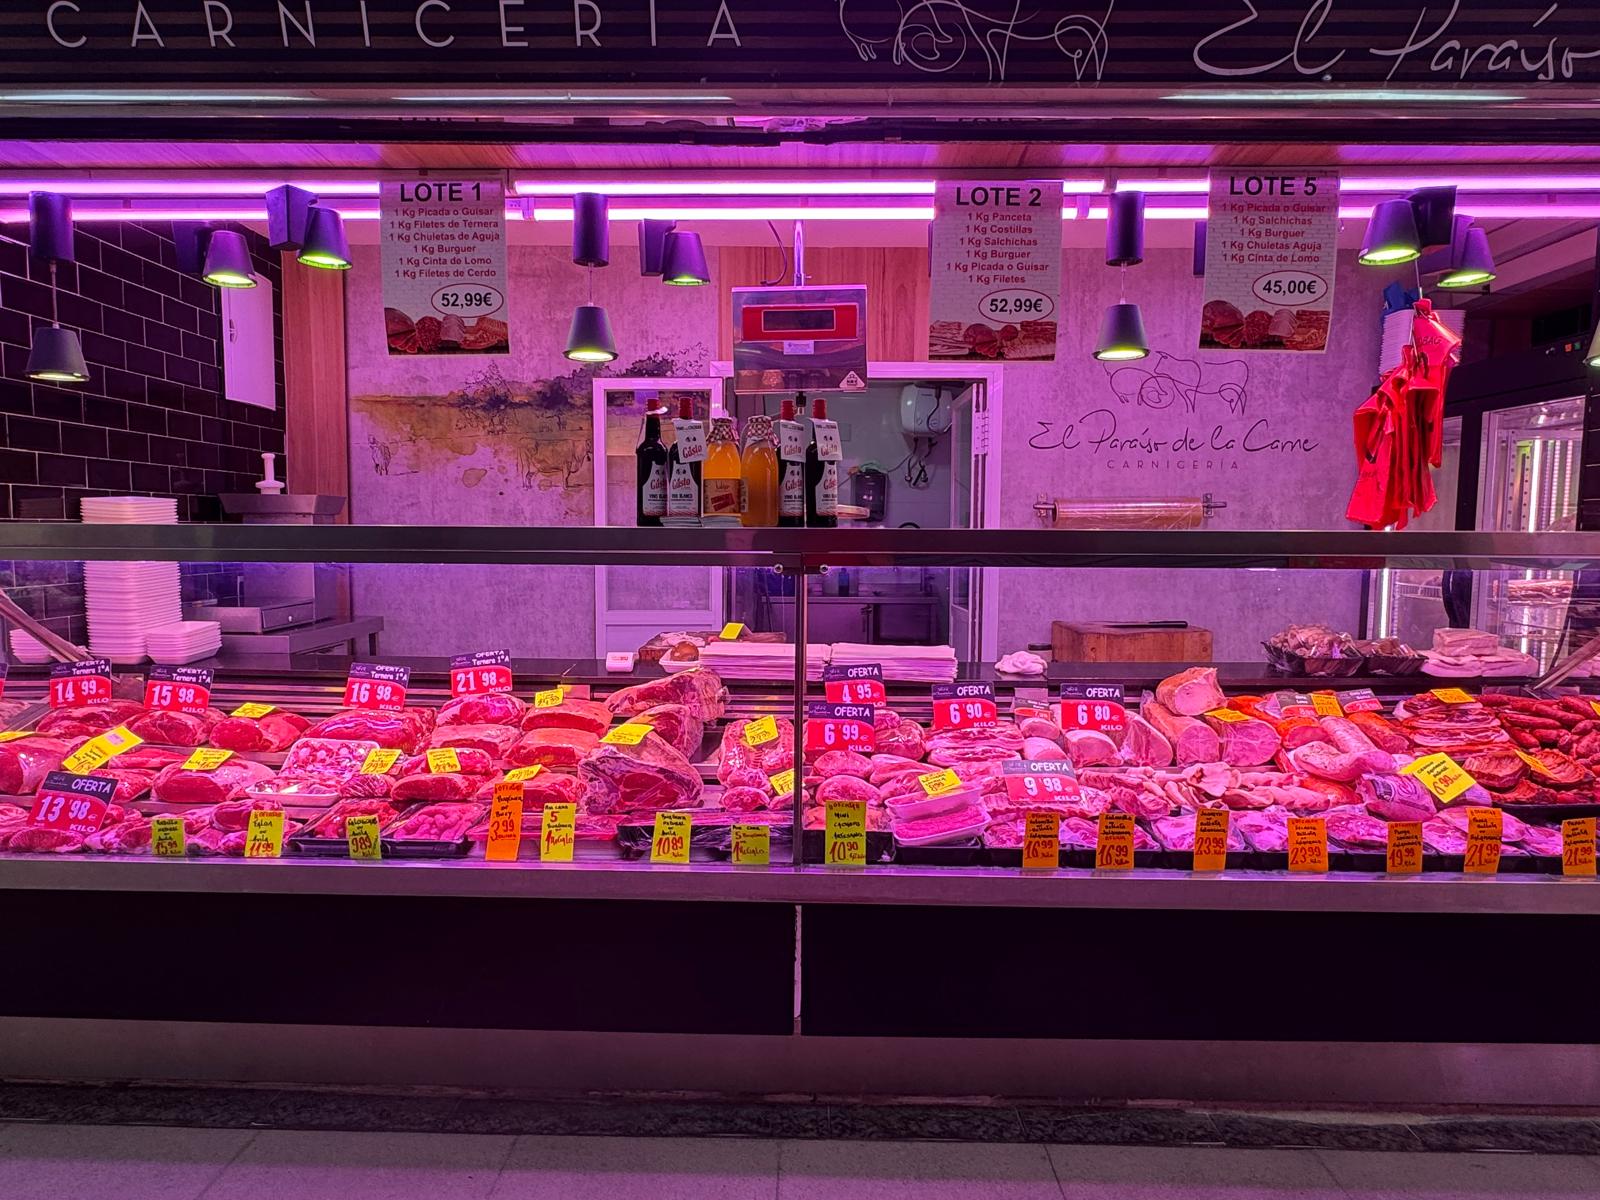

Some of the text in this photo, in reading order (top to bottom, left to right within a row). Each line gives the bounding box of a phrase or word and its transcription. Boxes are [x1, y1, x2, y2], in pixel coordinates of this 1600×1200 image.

[1229, 176, 1317, 196] LOTE 5
[400, 183, 482, 202] LOTE 1
[956, 187, 1042, 206] LOTE 2
[402, 208, 416, 218] Kg
[418, 208, 450, 216] Picada
[461, 208, 494, 216] Guisar
[1230, 203, 1244, 213] Kg
[1247, 203, 1280, 212] Picada
[1292, 203, 1326, 213] Guisar
[976, 213, 989, 222] Kg
[993, 213, 1032, 221] Panceta
[1242, 216, 1255, 226] Kg
[1258, 216, 1312, 225] Salchichas
[398, 220, 411, 230] Kg
[414, 220, 445, 229] Filetes
[448, 220, 459, 228] de
[463, 220, 499, 228] Ternera
[974, 225, 987, 235] Kg
[990, 225, 1033, 234] Costillas
[397, 233, 411, 243] Kg
[413, 233, 455, 241] Chuletas
[457, 233, 470, 241] de
[472, 233, 500, 242] Aguja
[1248, 229, 1262, 238] Kg
[1265, 228, 1305, 239] Burguer
[968, 238, 981, 247] Kg
[984, 237, 1038, 246] Salchichas
[1230, 241, 1244, 251] Kg
[1247, 240, 1290, 250] Chuletas
[1292, 241, 1322, 252] Aguja
[421, 245, 435, 255] Kg
[437, 245, 477, 255] Burguer
[974, 250, 988, 260] Kg
[990, 250, 1031, 260] Burguer
[406, 257, 420, 267] Kg
[422, 257, 447, 265] Cinta
[450, 257, 461, 265] de
[465, 257, 492, 265] Lomo
[1231, 254, 1245, 264] Kg
[1247, 253, 1273, 262] Cinta
[1276, 254, 1288, 262] de
[1291, 254, 1320, 262] Lomo
[954, 263, 968, 272] Kg
[971, 262, 1003, 271] Picada
[1016, 263, 1049, 271] Guisar
[403, 270, 416, 279] Kg
[419, 269, 450, 278] Filetes
[453, 270, 464, 278] de
[467, 269, 496, 277] Cerdo
[976, 275, 990, 285] Kg
[993, 275, 1026, 283] Filetes
[1262, 279, 1317, 297] 45,00€
[441, 292, 493, 309] 52,99€
[989, 298, 1043, 315] 52,99€
[1028, 408, 1320, 453] El Paraíso de la Carne
[1106, 459, 1239, 470] CARNICERÍA
[848, 667, 879, 677] OFERTA
[957, 685, 991, 696] OFERTA
[1086, 688, 1120, 697] OFERTA
[835, 707, 870, 716] OFERTA
[1031, 762, 1069, 771] OFERTA
[71, 779, 112, 793] OFERTA
[550, 811, 560, 822] 5
[69, 824, 96, 832] KILO
